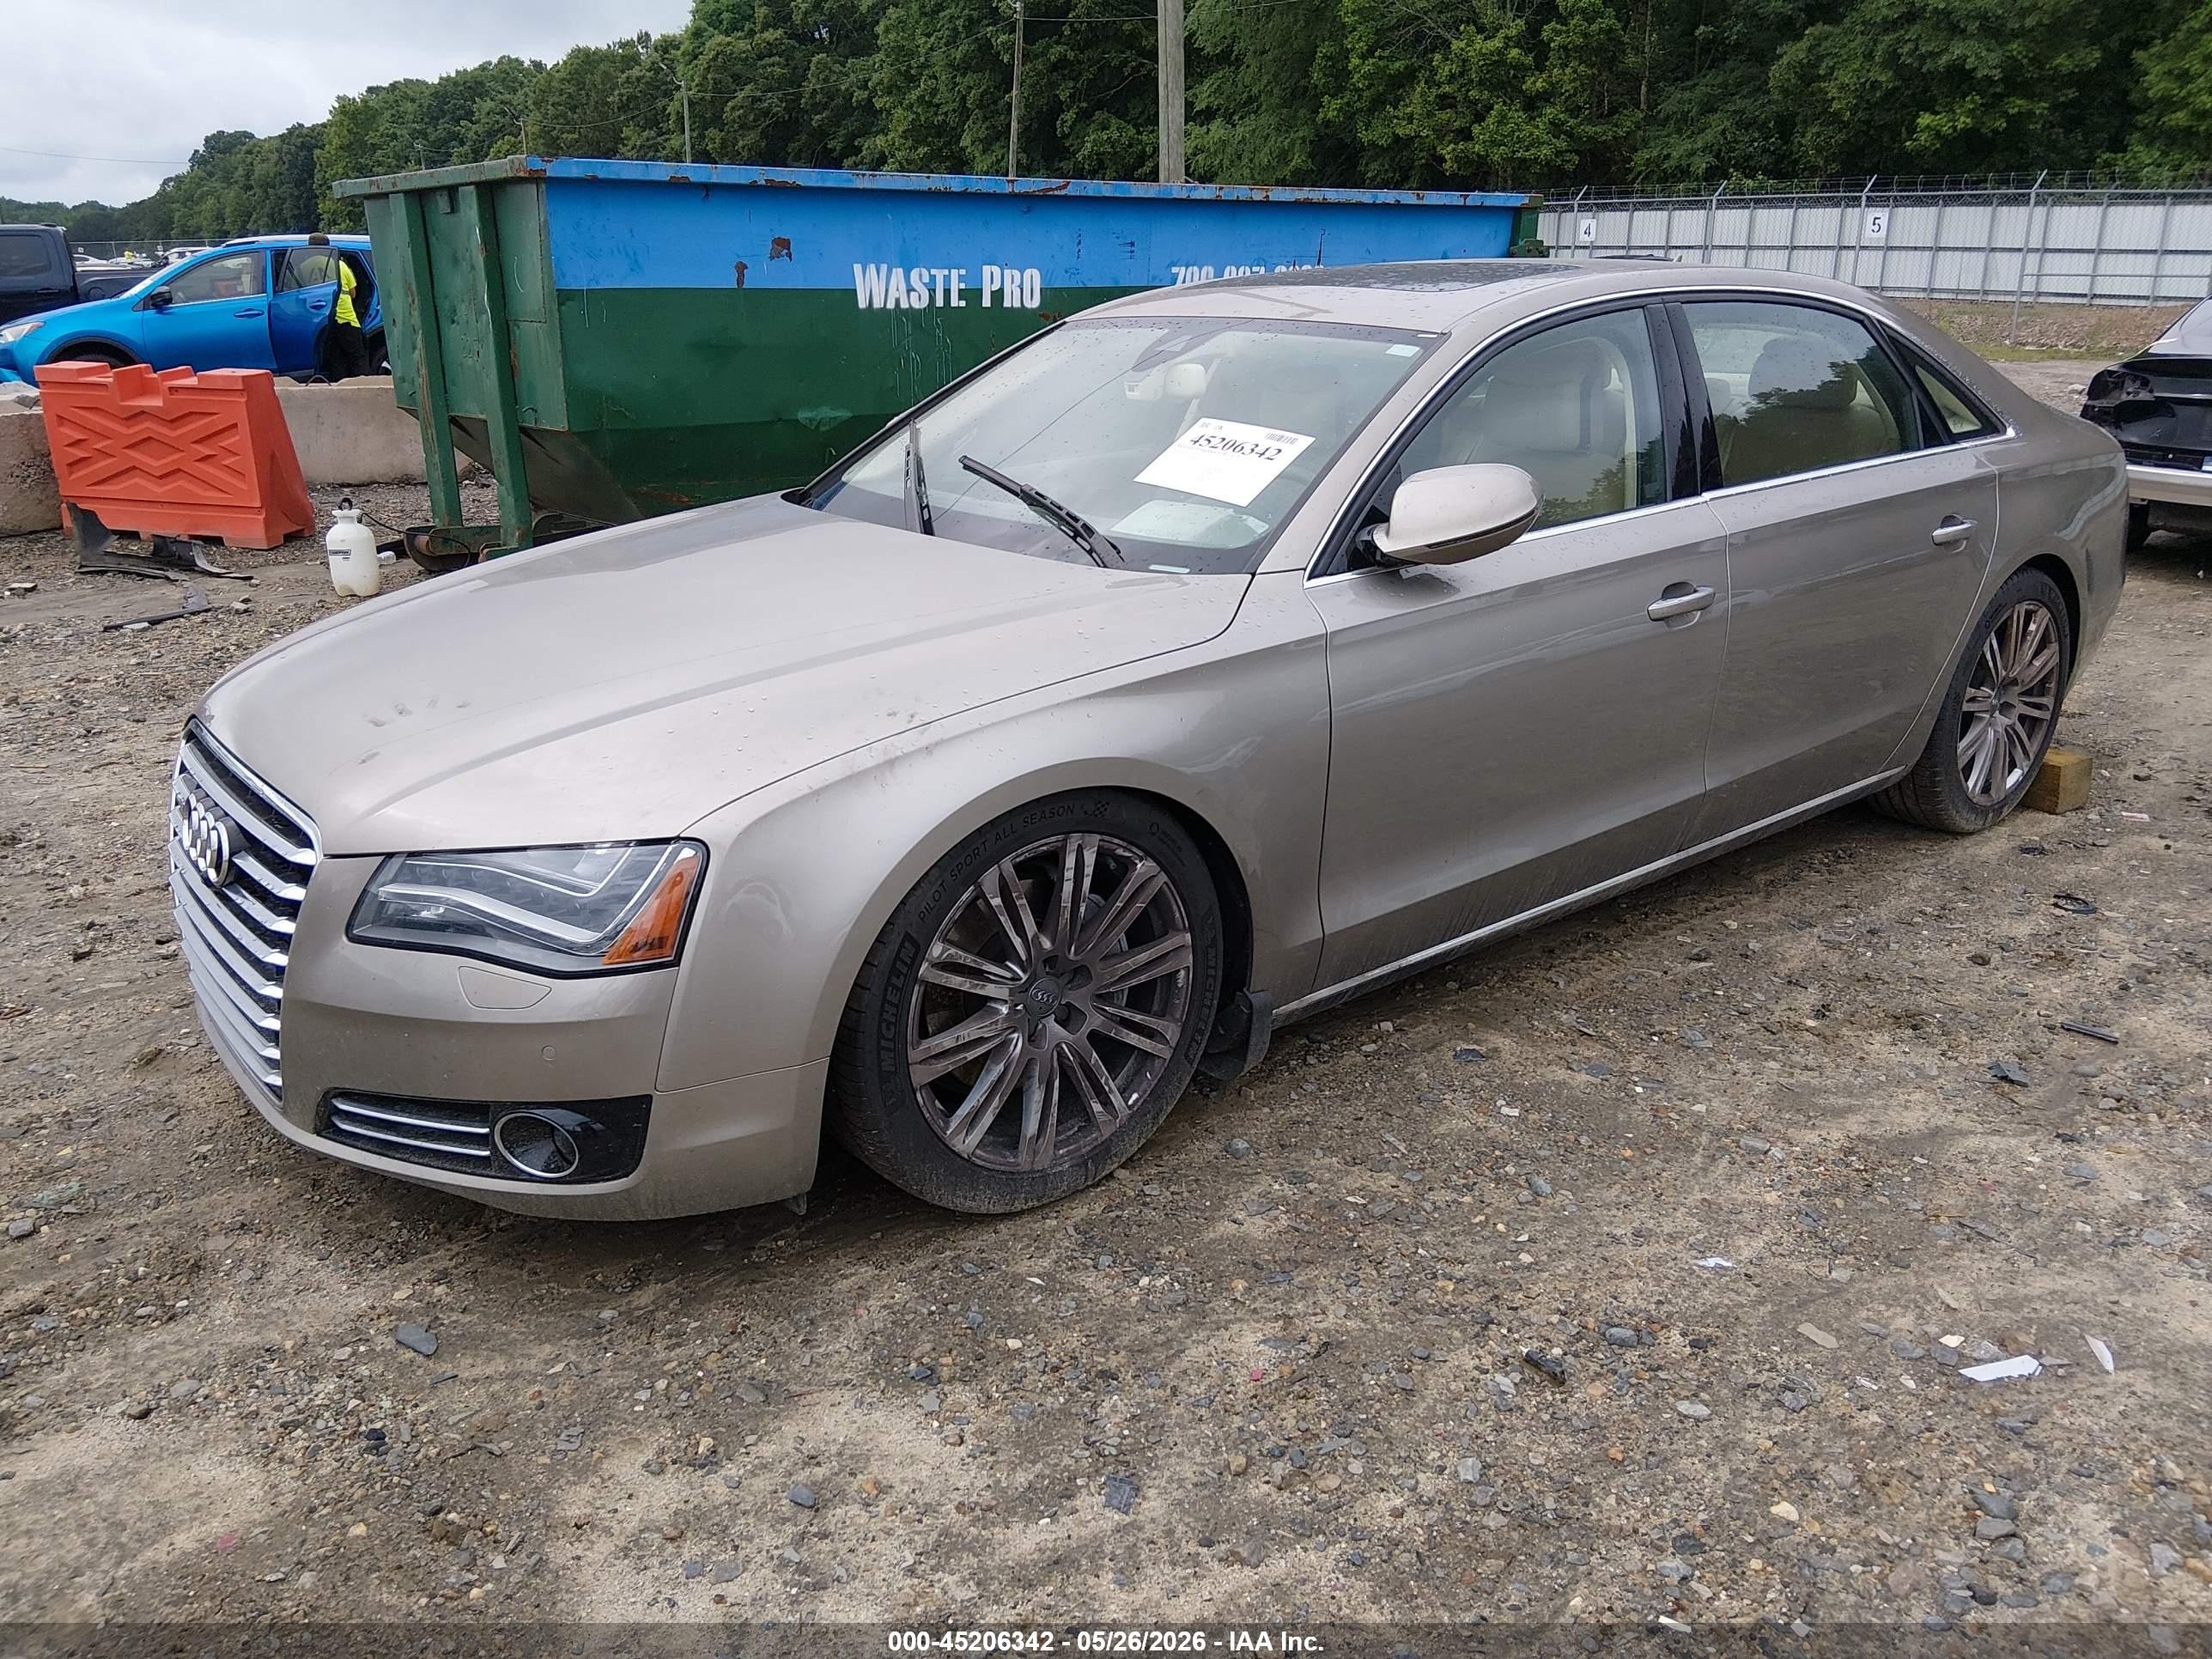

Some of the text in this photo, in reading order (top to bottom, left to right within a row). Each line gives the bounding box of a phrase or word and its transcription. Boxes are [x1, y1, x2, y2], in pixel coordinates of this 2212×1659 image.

[1583, 222, 1591, 238] 4
[1871, 216, 1881, 234] 5
[1190, 434, 1283, 461] 45206342
[917, 803, 1076, 922] PILOT SPORT ALL SEASON
[880, 939, 916, 1073] MICHELIN
